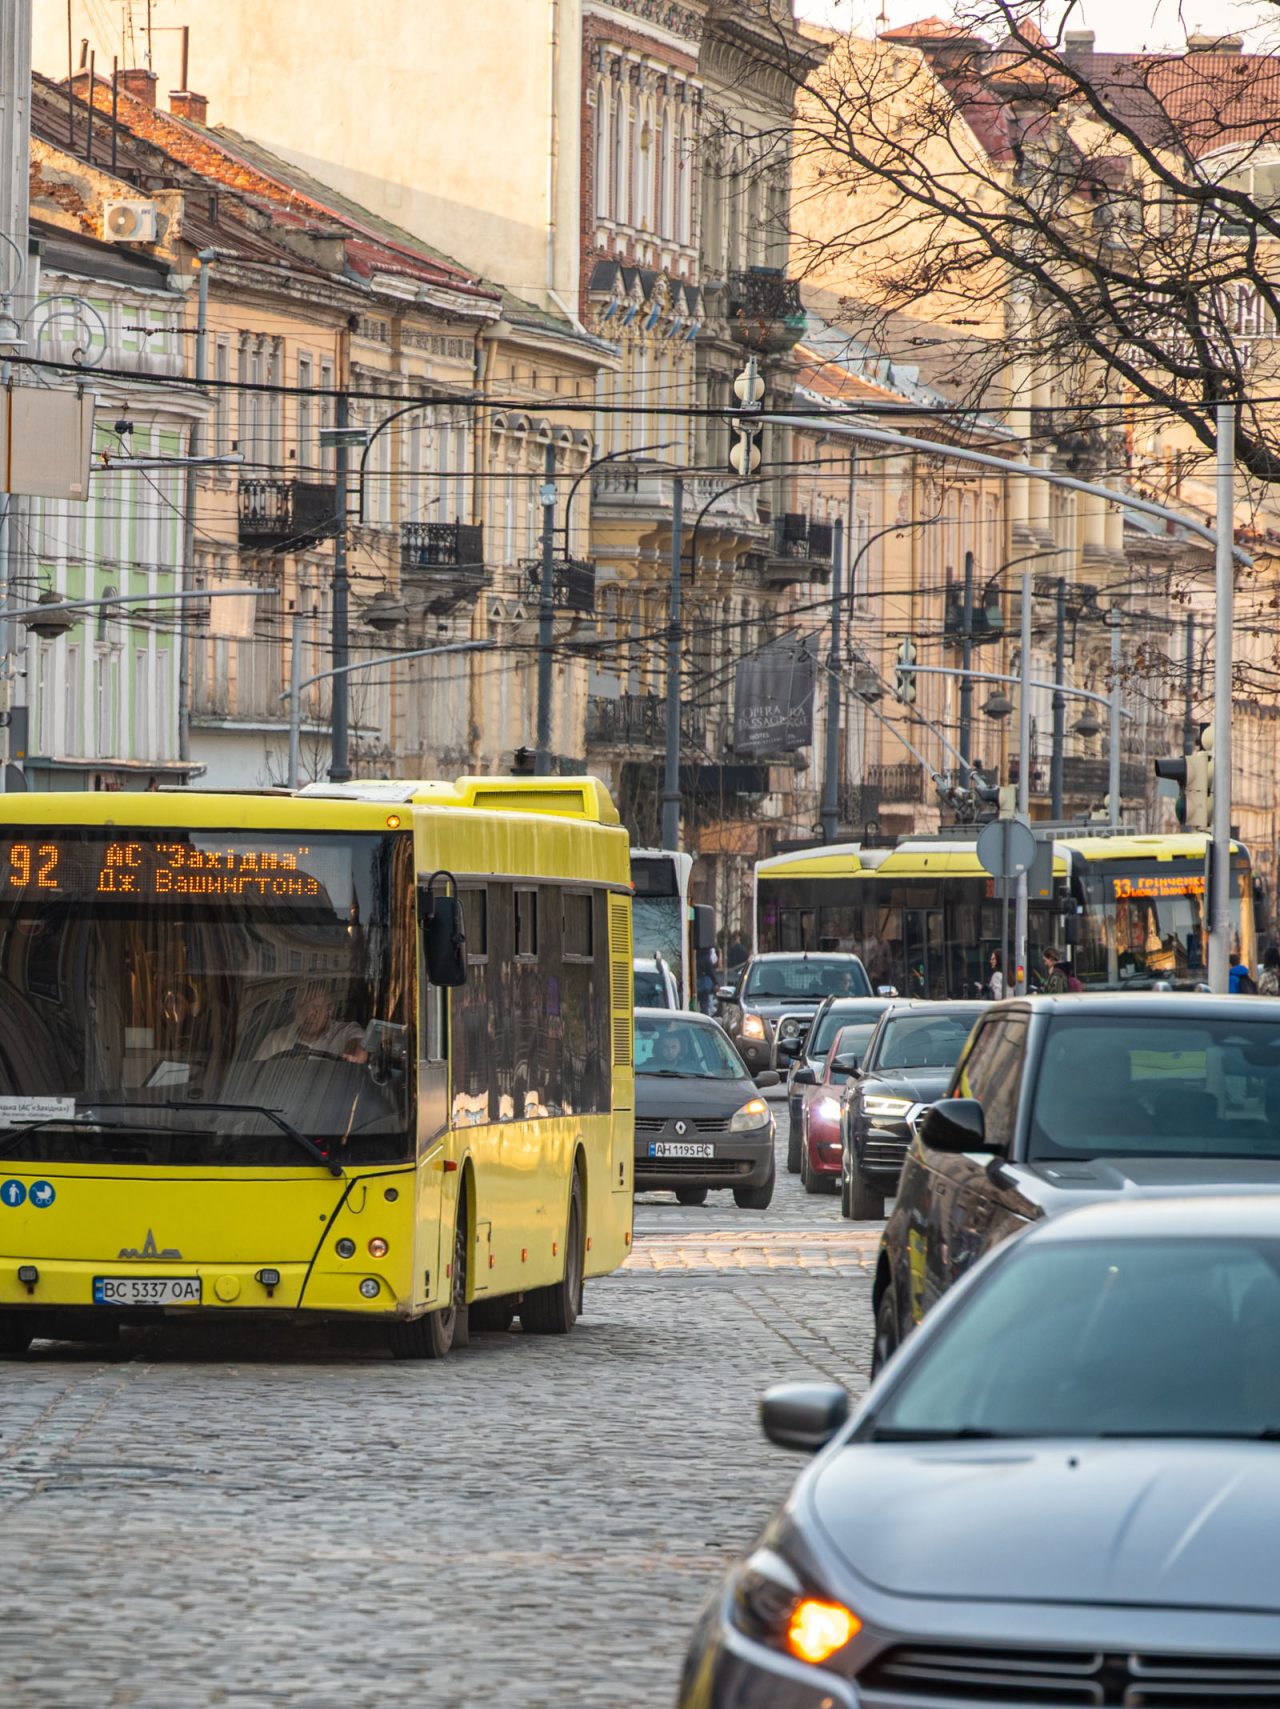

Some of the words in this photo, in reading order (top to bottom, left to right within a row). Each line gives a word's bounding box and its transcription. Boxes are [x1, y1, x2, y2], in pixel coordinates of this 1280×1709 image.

[10, 844, 58, 886] 92
[106, 843, 142, 866] АС
[97, 868, 141, 892] Дж.
[156, 869, 318, 895] Вашингтона
[673, 1145, 695, 1155] 1195
[104, 1281, 128, 1298] BC
[132, 1281, 167, 1298] 5337
[171, 1281, 195, 1298] OA
